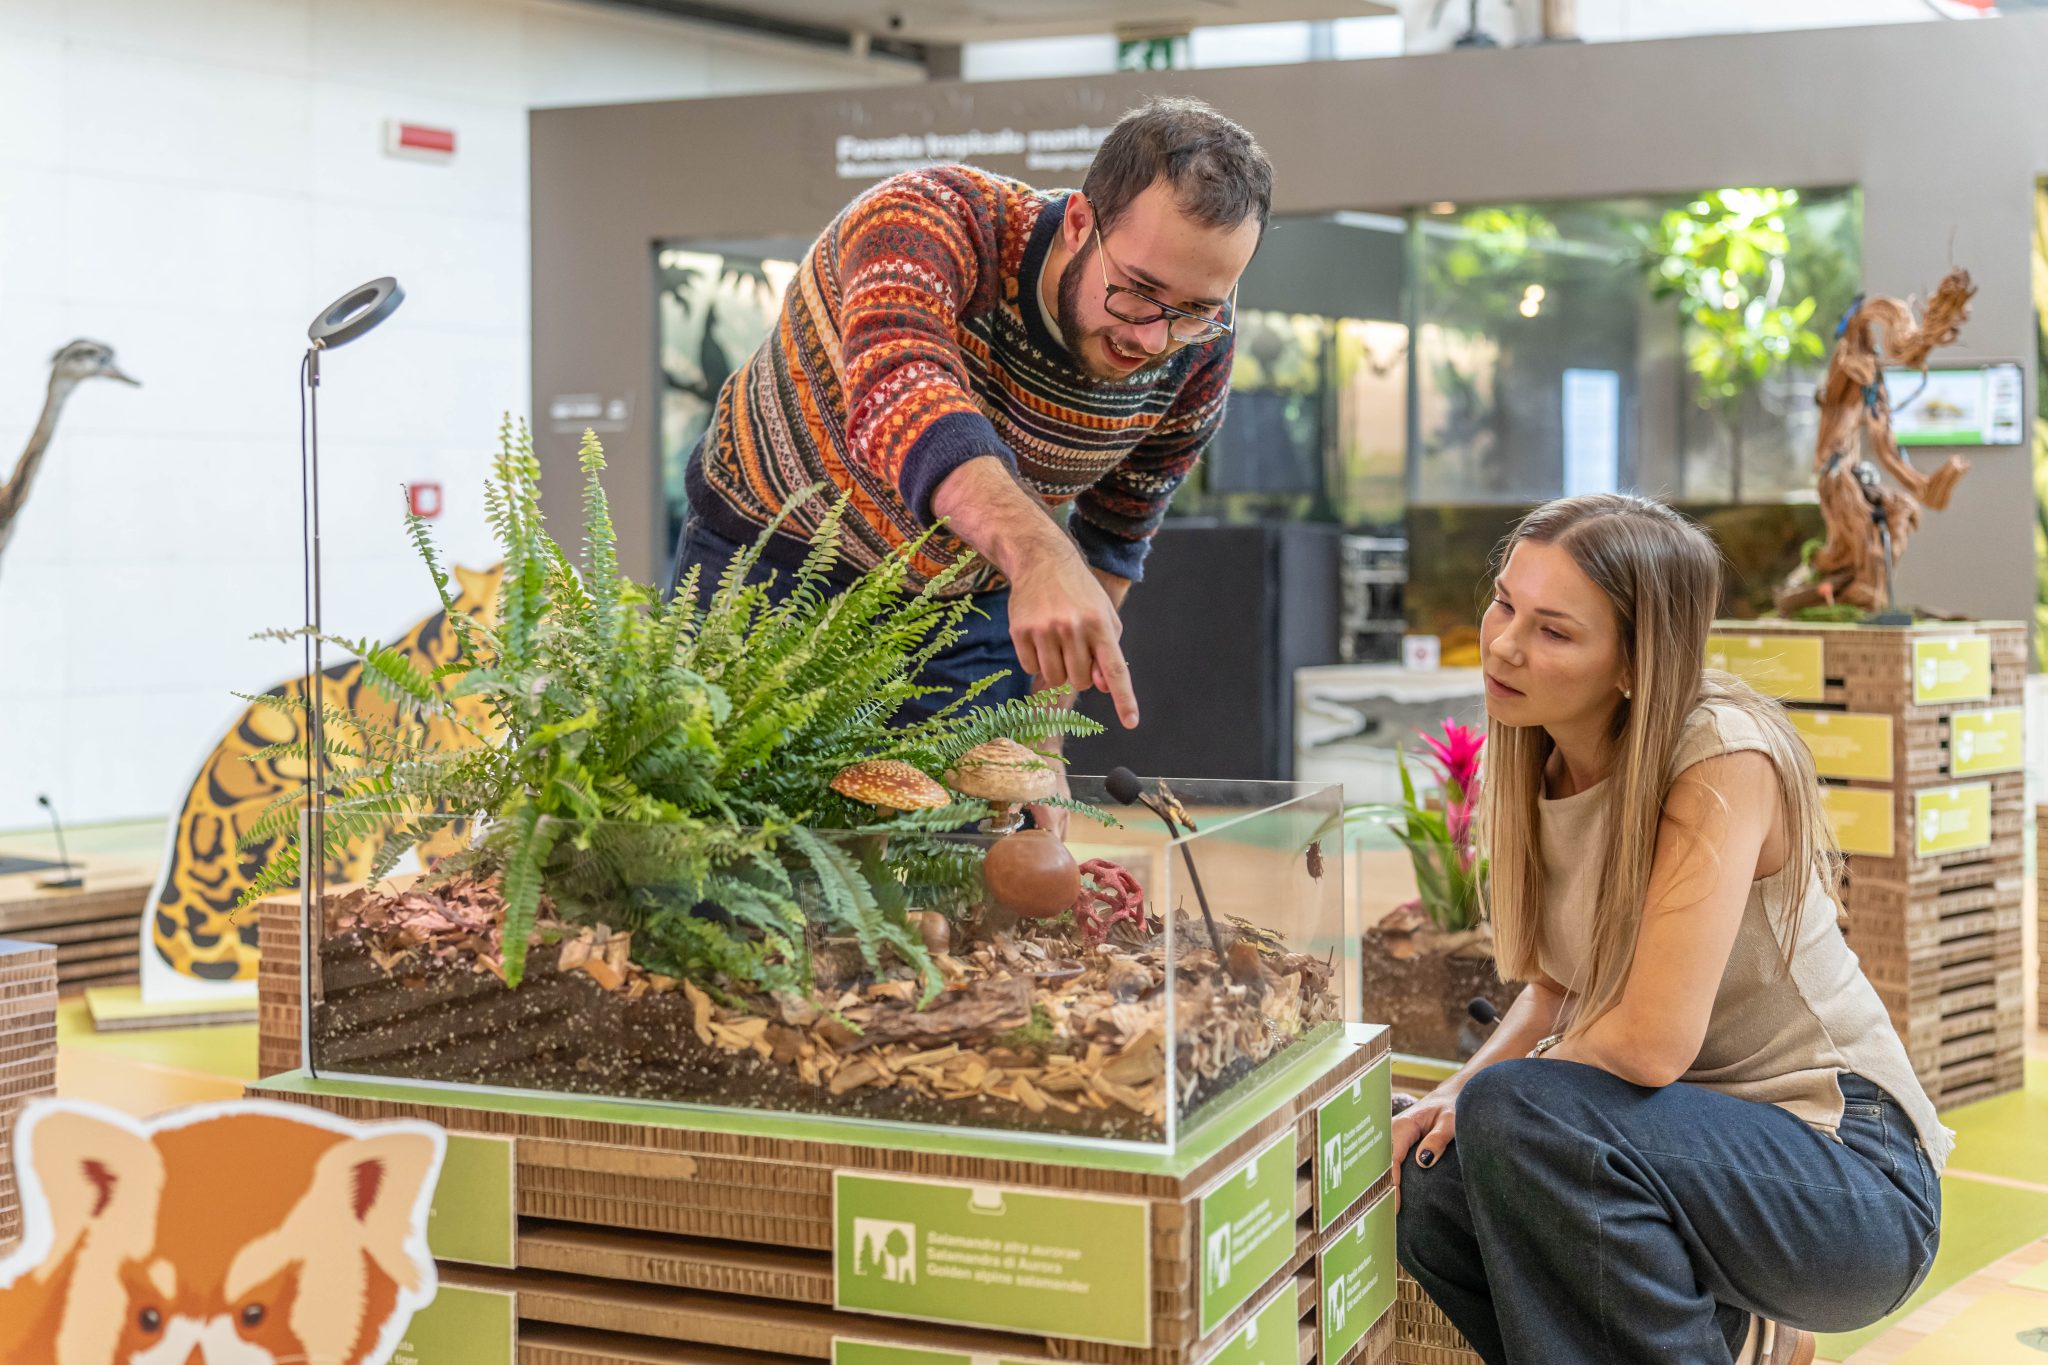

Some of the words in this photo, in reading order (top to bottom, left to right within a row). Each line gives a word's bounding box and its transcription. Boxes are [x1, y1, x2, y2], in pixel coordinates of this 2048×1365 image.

[925, 128, 1025, 158] tropicale
[927, 1230, 1002, 1251] Salamandra
[926, 1247, 1001, 1267] Salamandra
[1003, 1256, 1015, 1269] di
[926, 1263, 972, 1280] Golden
[974, 1270, 1013, 1284] alpine
[1016, 1275, 1090, 1293] salamander
